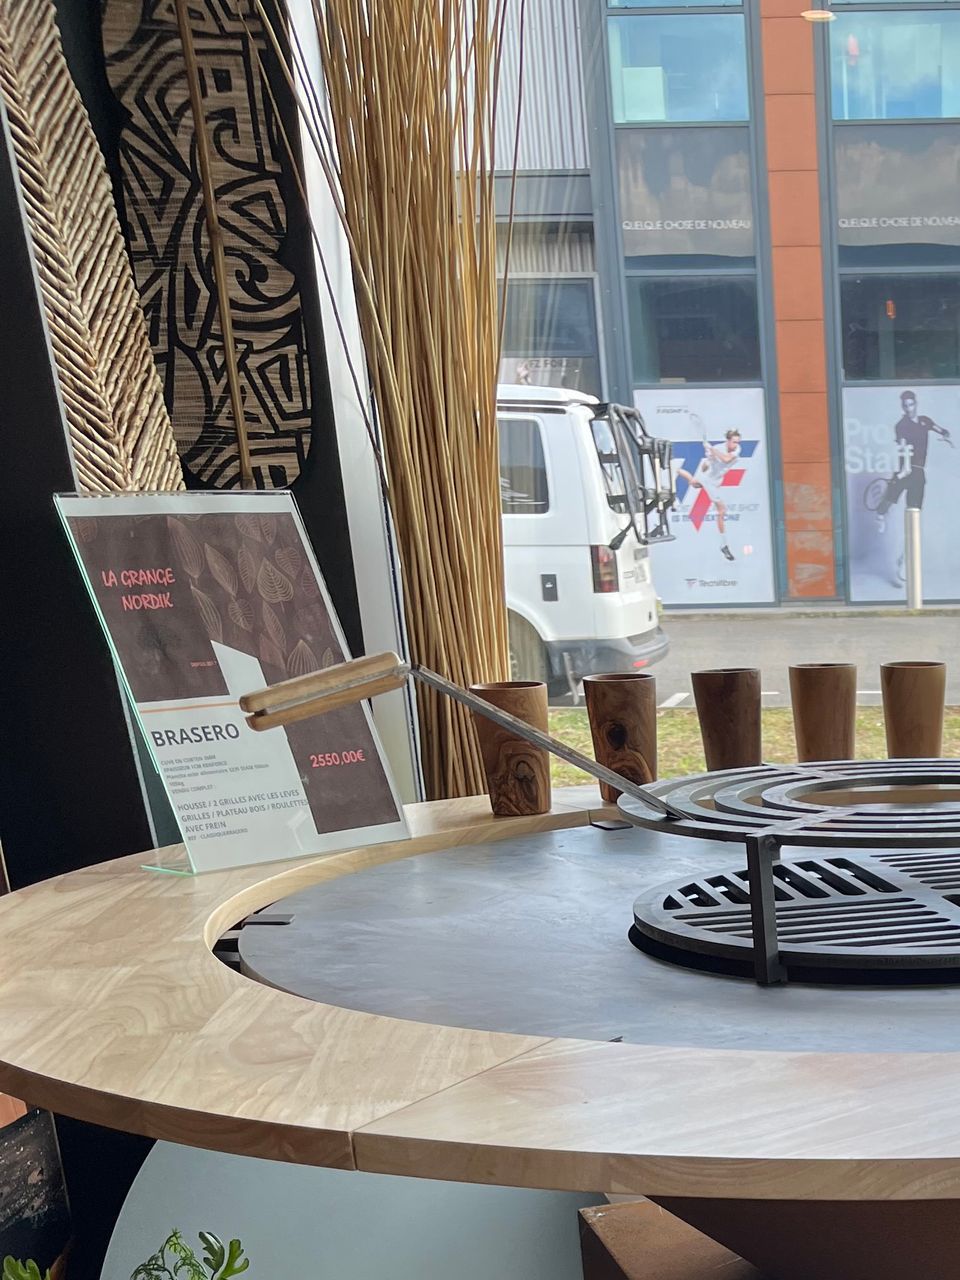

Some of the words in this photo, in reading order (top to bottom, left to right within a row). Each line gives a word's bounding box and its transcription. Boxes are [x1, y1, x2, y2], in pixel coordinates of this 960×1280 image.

[622, 220, 662, 230] QUELQUE
[663, 220, 694, 230] CHOSE
[695, 220, 706, 230] DE
[708, 219, 751, 229] NOUVEAU
[838, 218, 878, 228] QUELQUE
[880, 217, 909, 227] CHOSE
[910, 217, 922, 227] DE
[846, 418, 891, 445] Pro
[845, 445, 914, 474] Staff
[101, 569, 118, 587] LA
[120, 567, 176, 588] GRANGE
[121, 592, 174, 611] NORDIK
[151, 723, 240, 747] BRASERO
[309, 749, 366, 768] 2550,00€
[177, 801, 208, 811] HOUSSE
[219, 796, 247, 806] GRILLES
[248, 794, 266, 803] AVEC
[267, 792, 279, 800] LES
[280, 789, 300, 798] LEVES
[181, 812, 211, 823] GRILLES
[216, 807, 248, 818] PLATEAU
[249, 805, 266, 813] BOIS
[271, 800, 309, 810] ROULETTES
[185, 825, 204, 833] AVEC
[205, 821, 227, 830] FREIN
